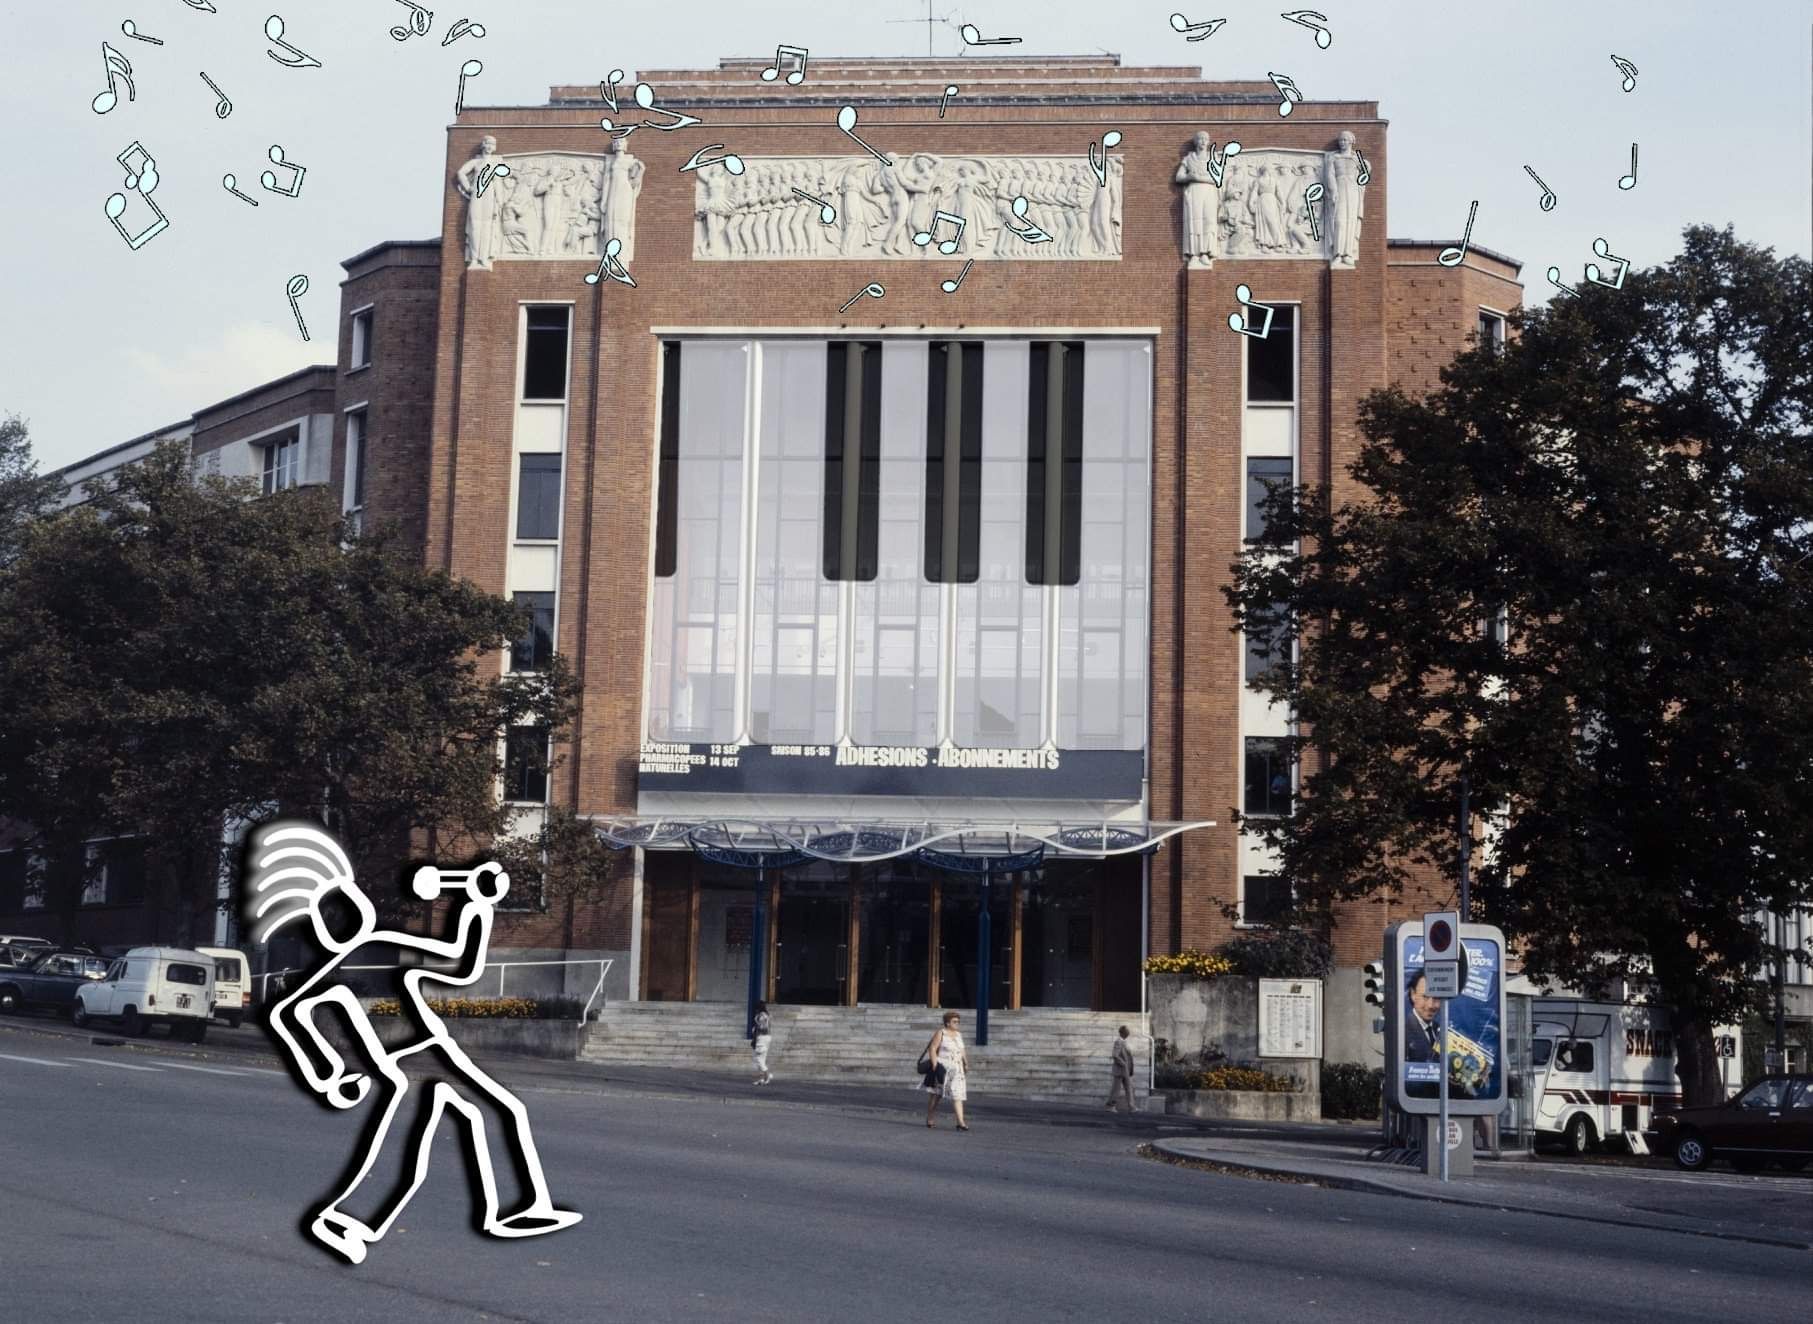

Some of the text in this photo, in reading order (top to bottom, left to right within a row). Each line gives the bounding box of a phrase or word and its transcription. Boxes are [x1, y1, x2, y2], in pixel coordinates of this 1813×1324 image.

[640, 744, 690, 754] EXPOSITION
[711, 745, 740, 755] 13 SEP
[771, 745, 802, 756] SAISON
[639, 753, 706, 765] PHARMACOPEES
[710, 757, 740, 767] 14 OCT
[835, 747, 928, 767] ADHESIONS
[937, 748, 1060, 770] ABONNEMENTS
[639, 763, 690, 773] NATURELLES
